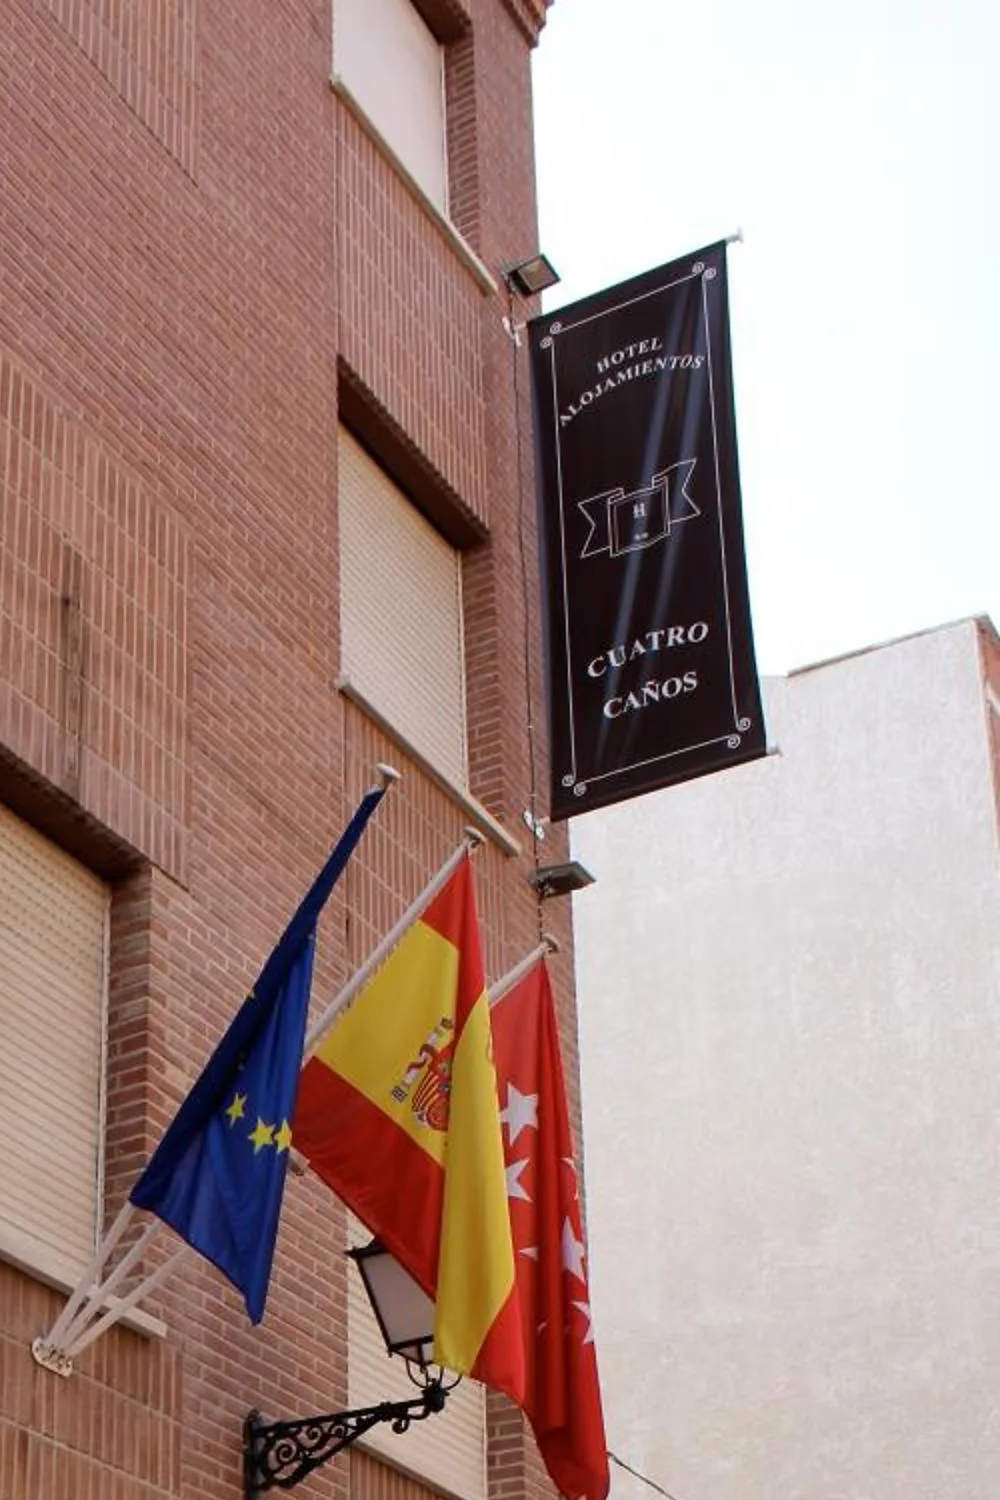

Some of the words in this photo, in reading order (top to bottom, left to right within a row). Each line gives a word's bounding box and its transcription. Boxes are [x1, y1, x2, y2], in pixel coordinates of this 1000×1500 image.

[597, 336, 663, 374] HOTEL
[560, 354, 705, 427] ALOJAMIENTOS
[587, 621, 709, 678] CUATRO
[603, 671, 698, 719] CAÑOS
